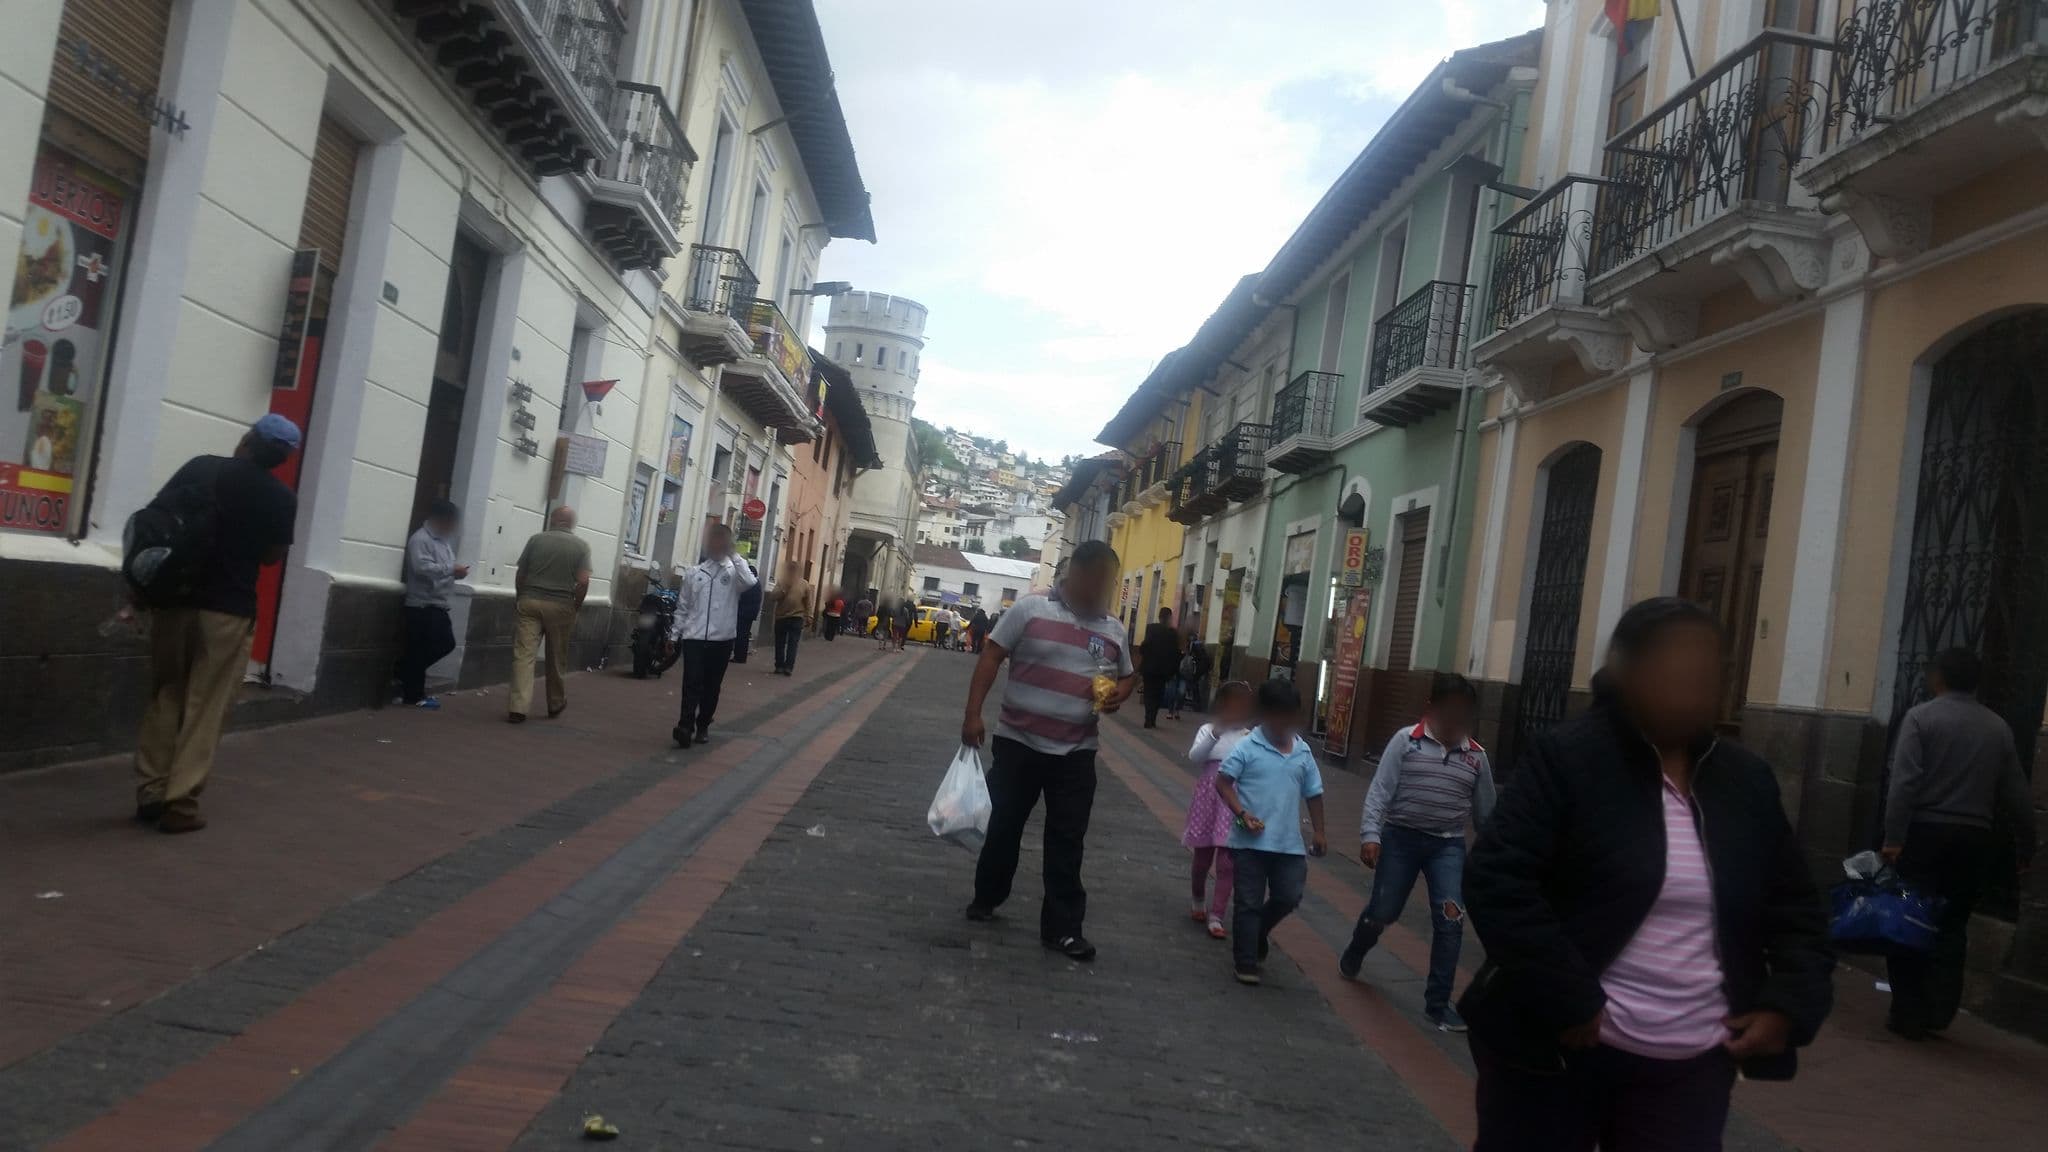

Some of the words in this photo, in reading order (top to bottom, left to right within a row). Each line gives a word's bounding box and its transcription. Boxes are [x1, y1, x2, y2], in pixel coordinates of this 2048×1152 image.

[33, 163, 119, 230] UERZOS
[0, 490, 65, 528] UNOS
[1346, 535, 1363, 568] ORO
